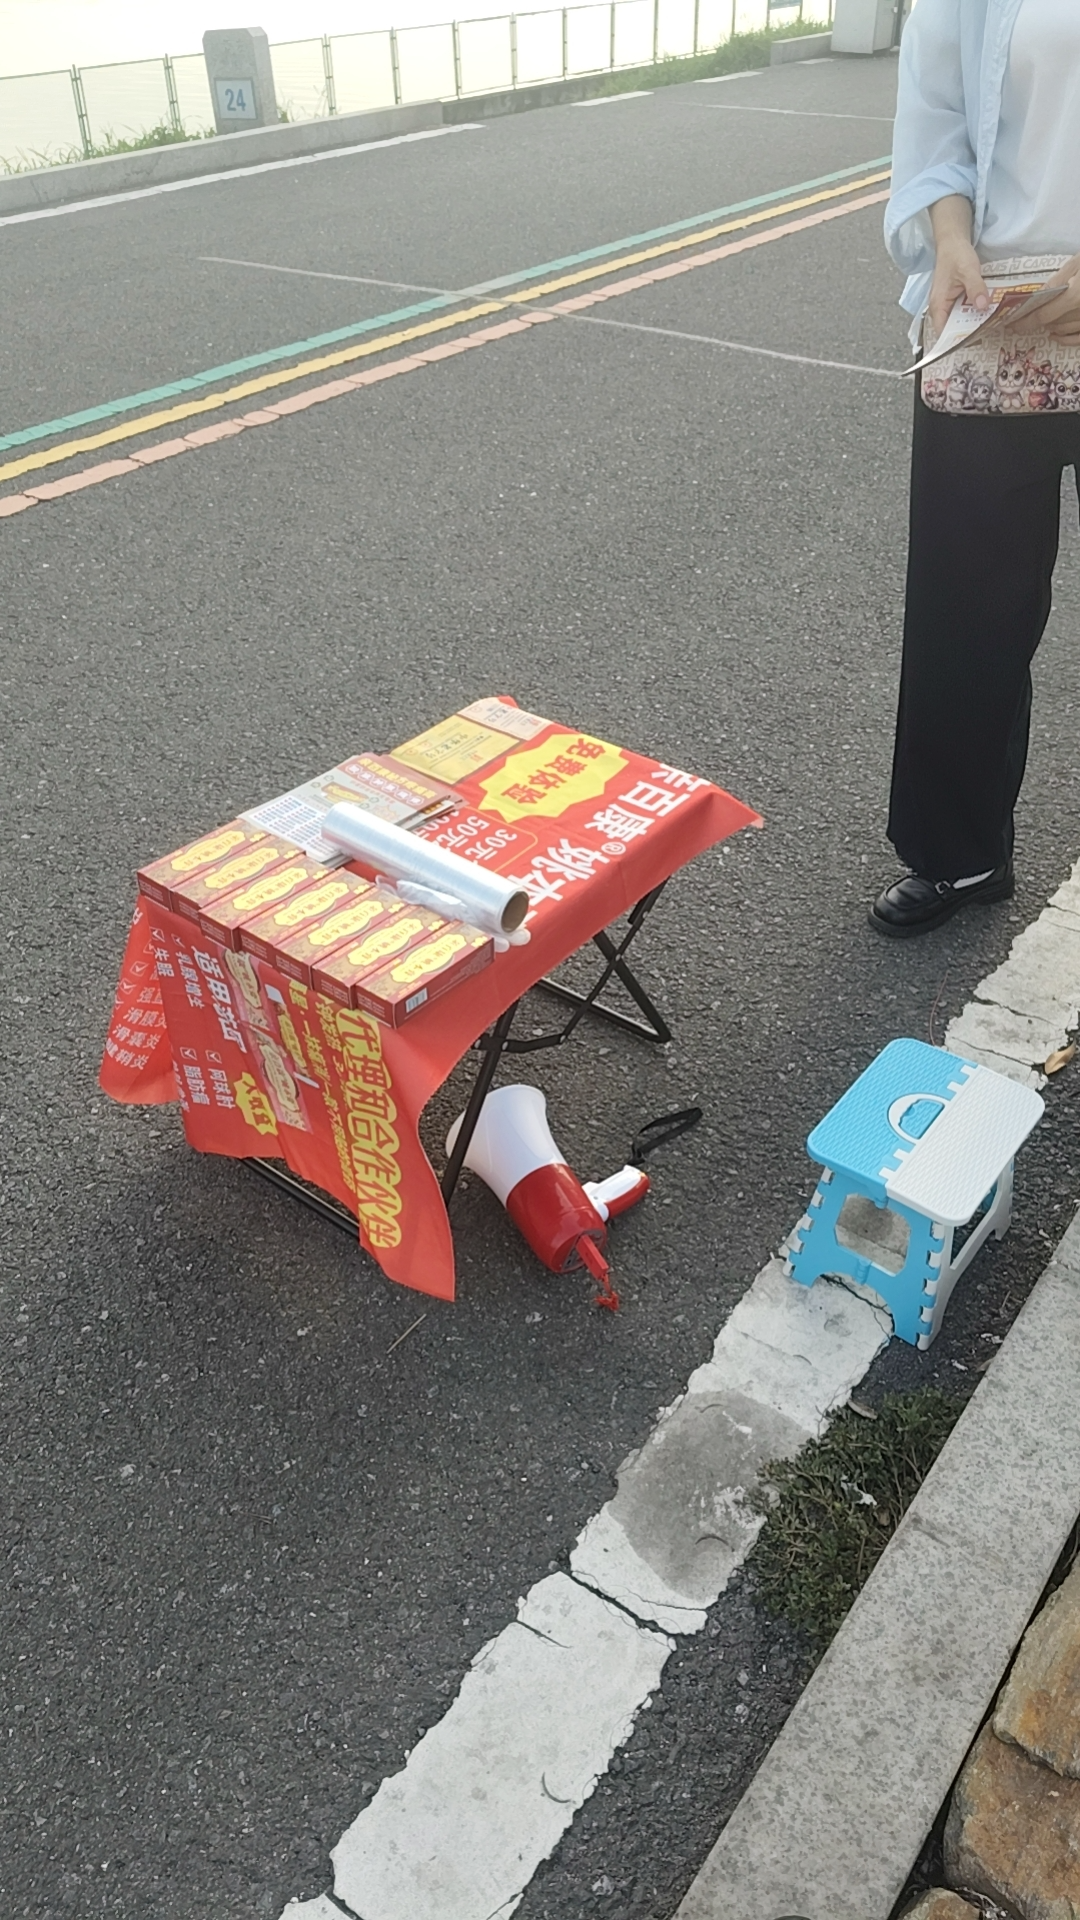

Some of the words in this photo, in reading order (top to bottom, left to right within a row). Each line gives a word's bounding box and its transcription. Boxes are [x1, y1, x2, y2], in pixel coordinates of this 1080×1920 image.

[225, 88, 246, 112] 24
[983, 261, 1009, 273] OUIS
[1022, 256, 1067, 270] CARDY
[501, 738, 606, 805] 免费体验
[337, 1008, 402, 1248] 代理和合作伙伴
